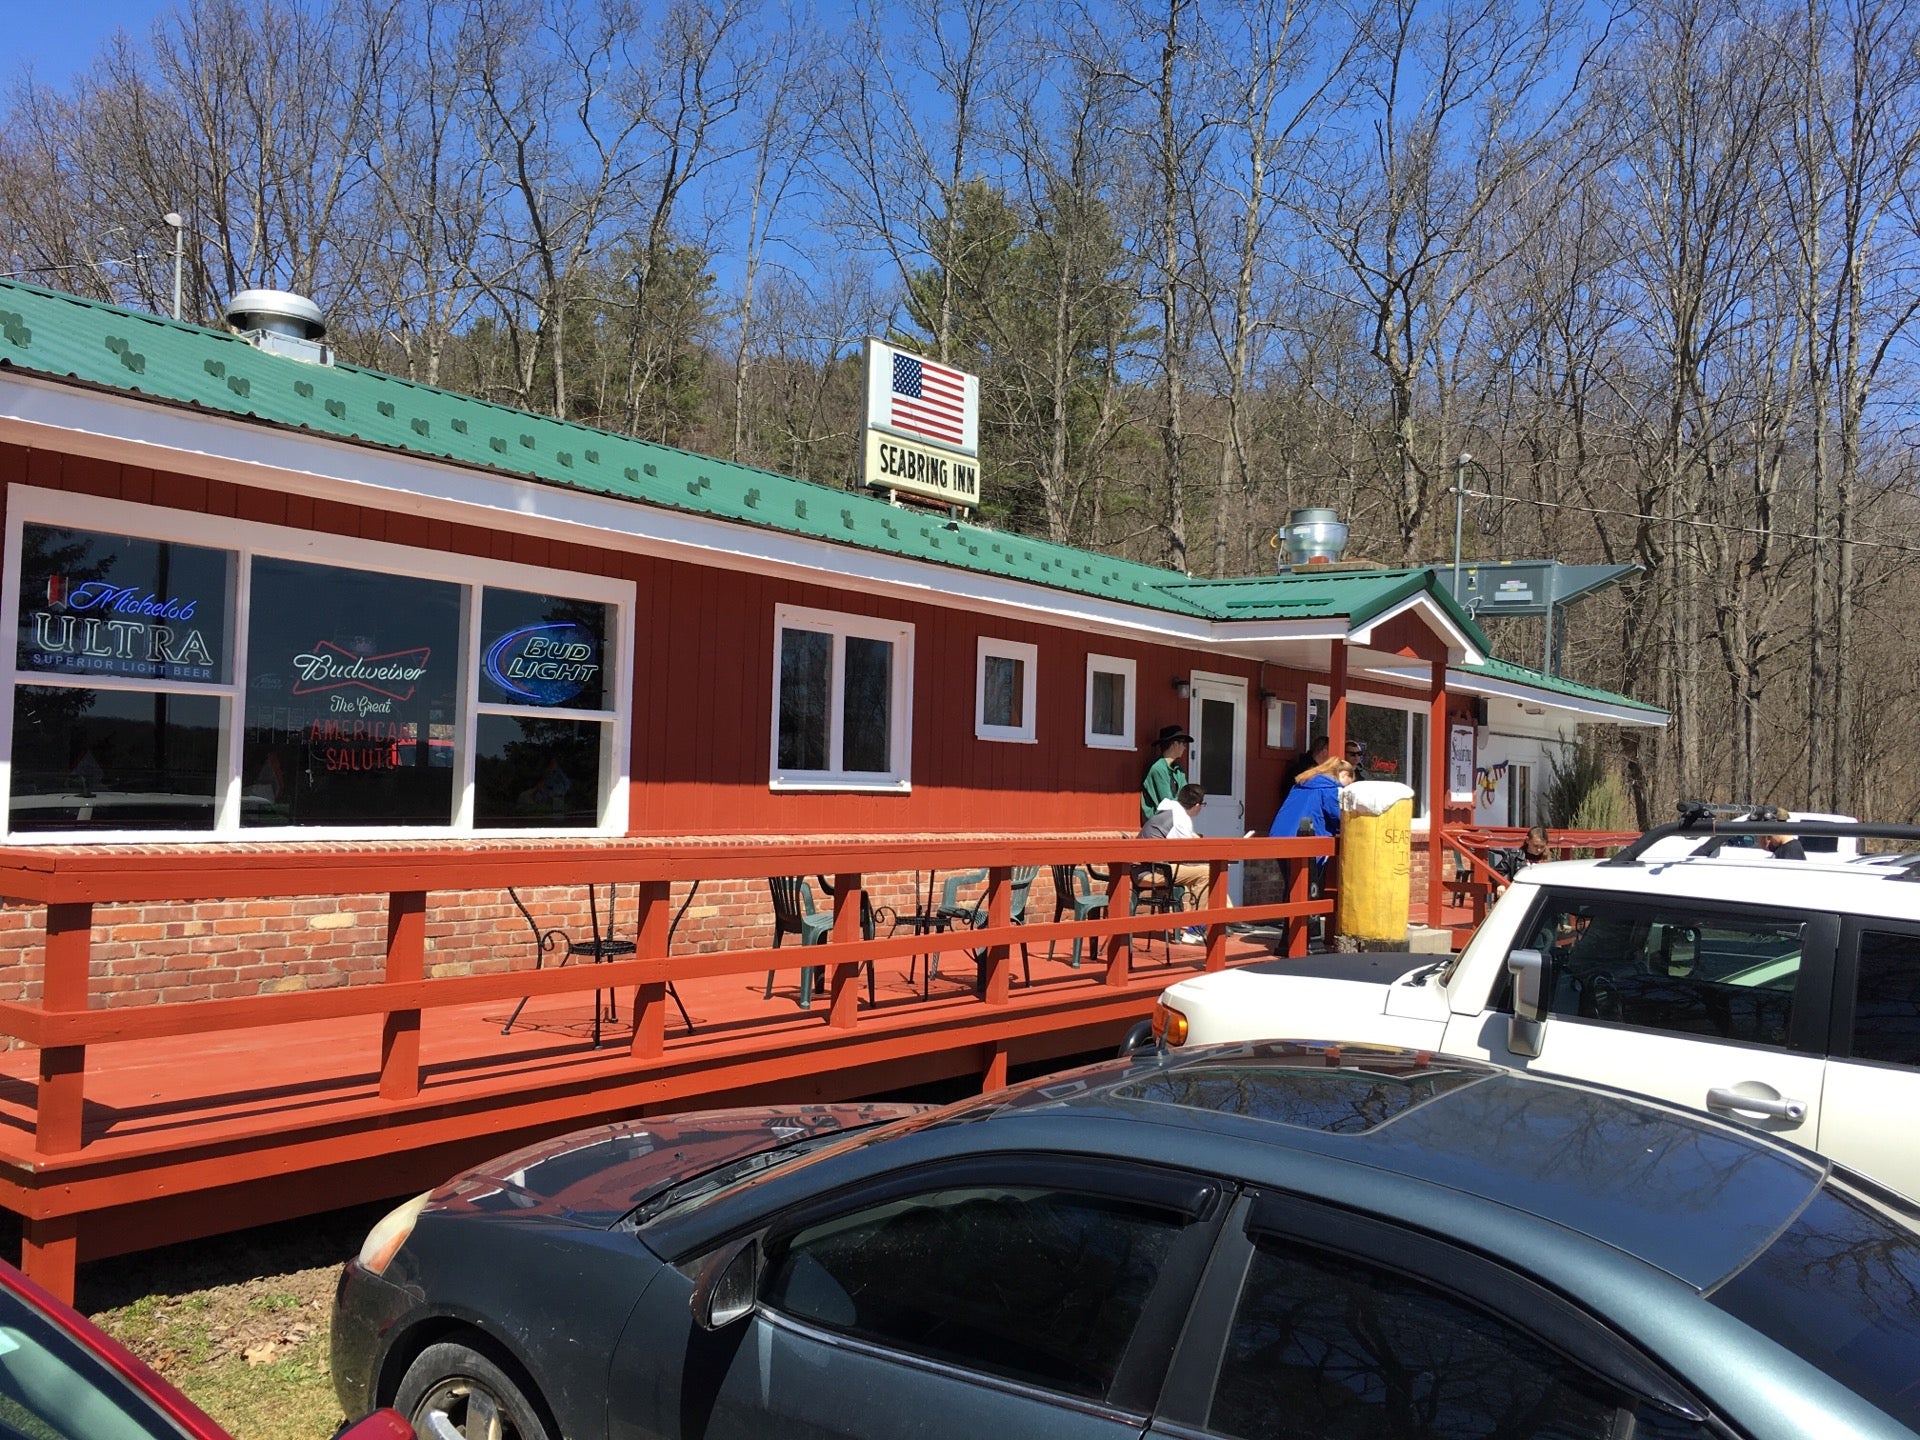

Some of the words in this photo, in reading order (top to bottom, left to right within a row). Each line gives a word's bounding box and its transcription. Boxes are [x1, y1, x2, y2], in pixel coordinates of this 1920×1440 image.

[880, 444, 948, 488] SEABRING
[953, 463, 975, 495] INN
[69, 582, 197, 621] Michelob
[36, 612, 214, 665] ULTRA
[523, 636, 591, 662] BUD
[33, 653, 114, 670] SUPERIOR
[121, 662, 167, 676] LIGHT
[173, 666, 212, 679] BEER
[293, 654, 426, 681] Budweiser
[507, 657, 599, 682] LIGHT
[330, 695, 355, 713] The
[357, 695, 391, 717] Great
[309, 718, 412, 743] AMERICAN
